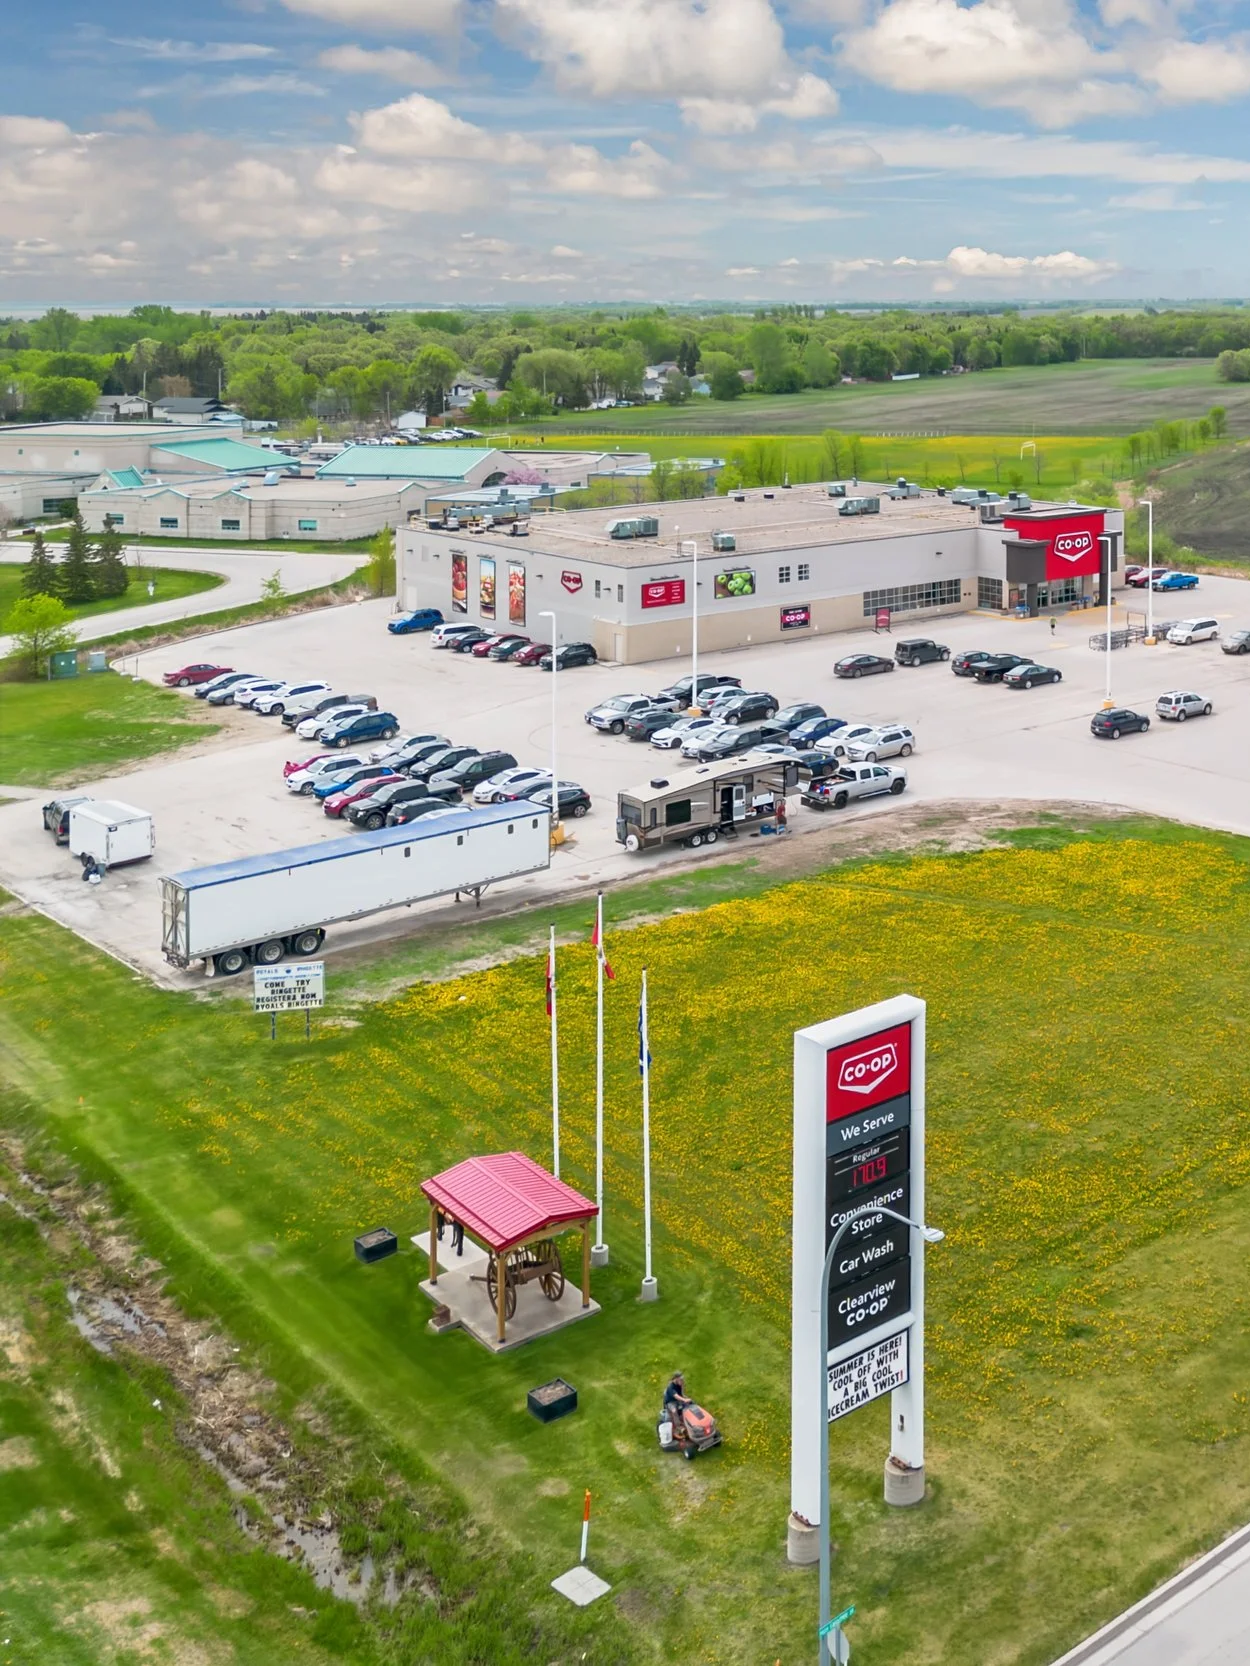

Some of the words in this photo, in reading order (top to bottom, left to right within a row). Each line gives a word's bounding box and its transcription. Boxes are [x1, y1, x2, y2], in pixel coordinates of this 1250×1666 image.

[271, 987, 306, 995] RINGETTE
[295, 979, 311, 987] TRY
[288, 999, 323, 1008] RINGETTE
[841, 1123, 861, 1142] We
[863, 1111, 895, 1134] Serve
[852, 1147, 880, 1163] Regular
[853, 1156, 887, 1187] 170.9
[851, 1213, 883, 1235] Store
[839, 1256, 860, 1275] Car
[862, 1240, 894, 1265] Wash
[838, 1279, 896, 1314] Clearview
[828, 1356, 864, 1383] SUMMER
[867, 1350, 875, 1362] IS
[879, 1336, 902, 1356] HERE!
[832, 1373, 855, 1391] COOL
[857, 1363, 872, 1378] OFF
[876, 1349, 899, 1369] WITH
[828, 1388, 870, 1419] ICECREAM
[874, 1370, 904, 1393] TWIST!
[843, 1387, 849, 1399] A
[853, 1377, 868, 1393] BIG
[872, 1364, 893, 1382] COOL
